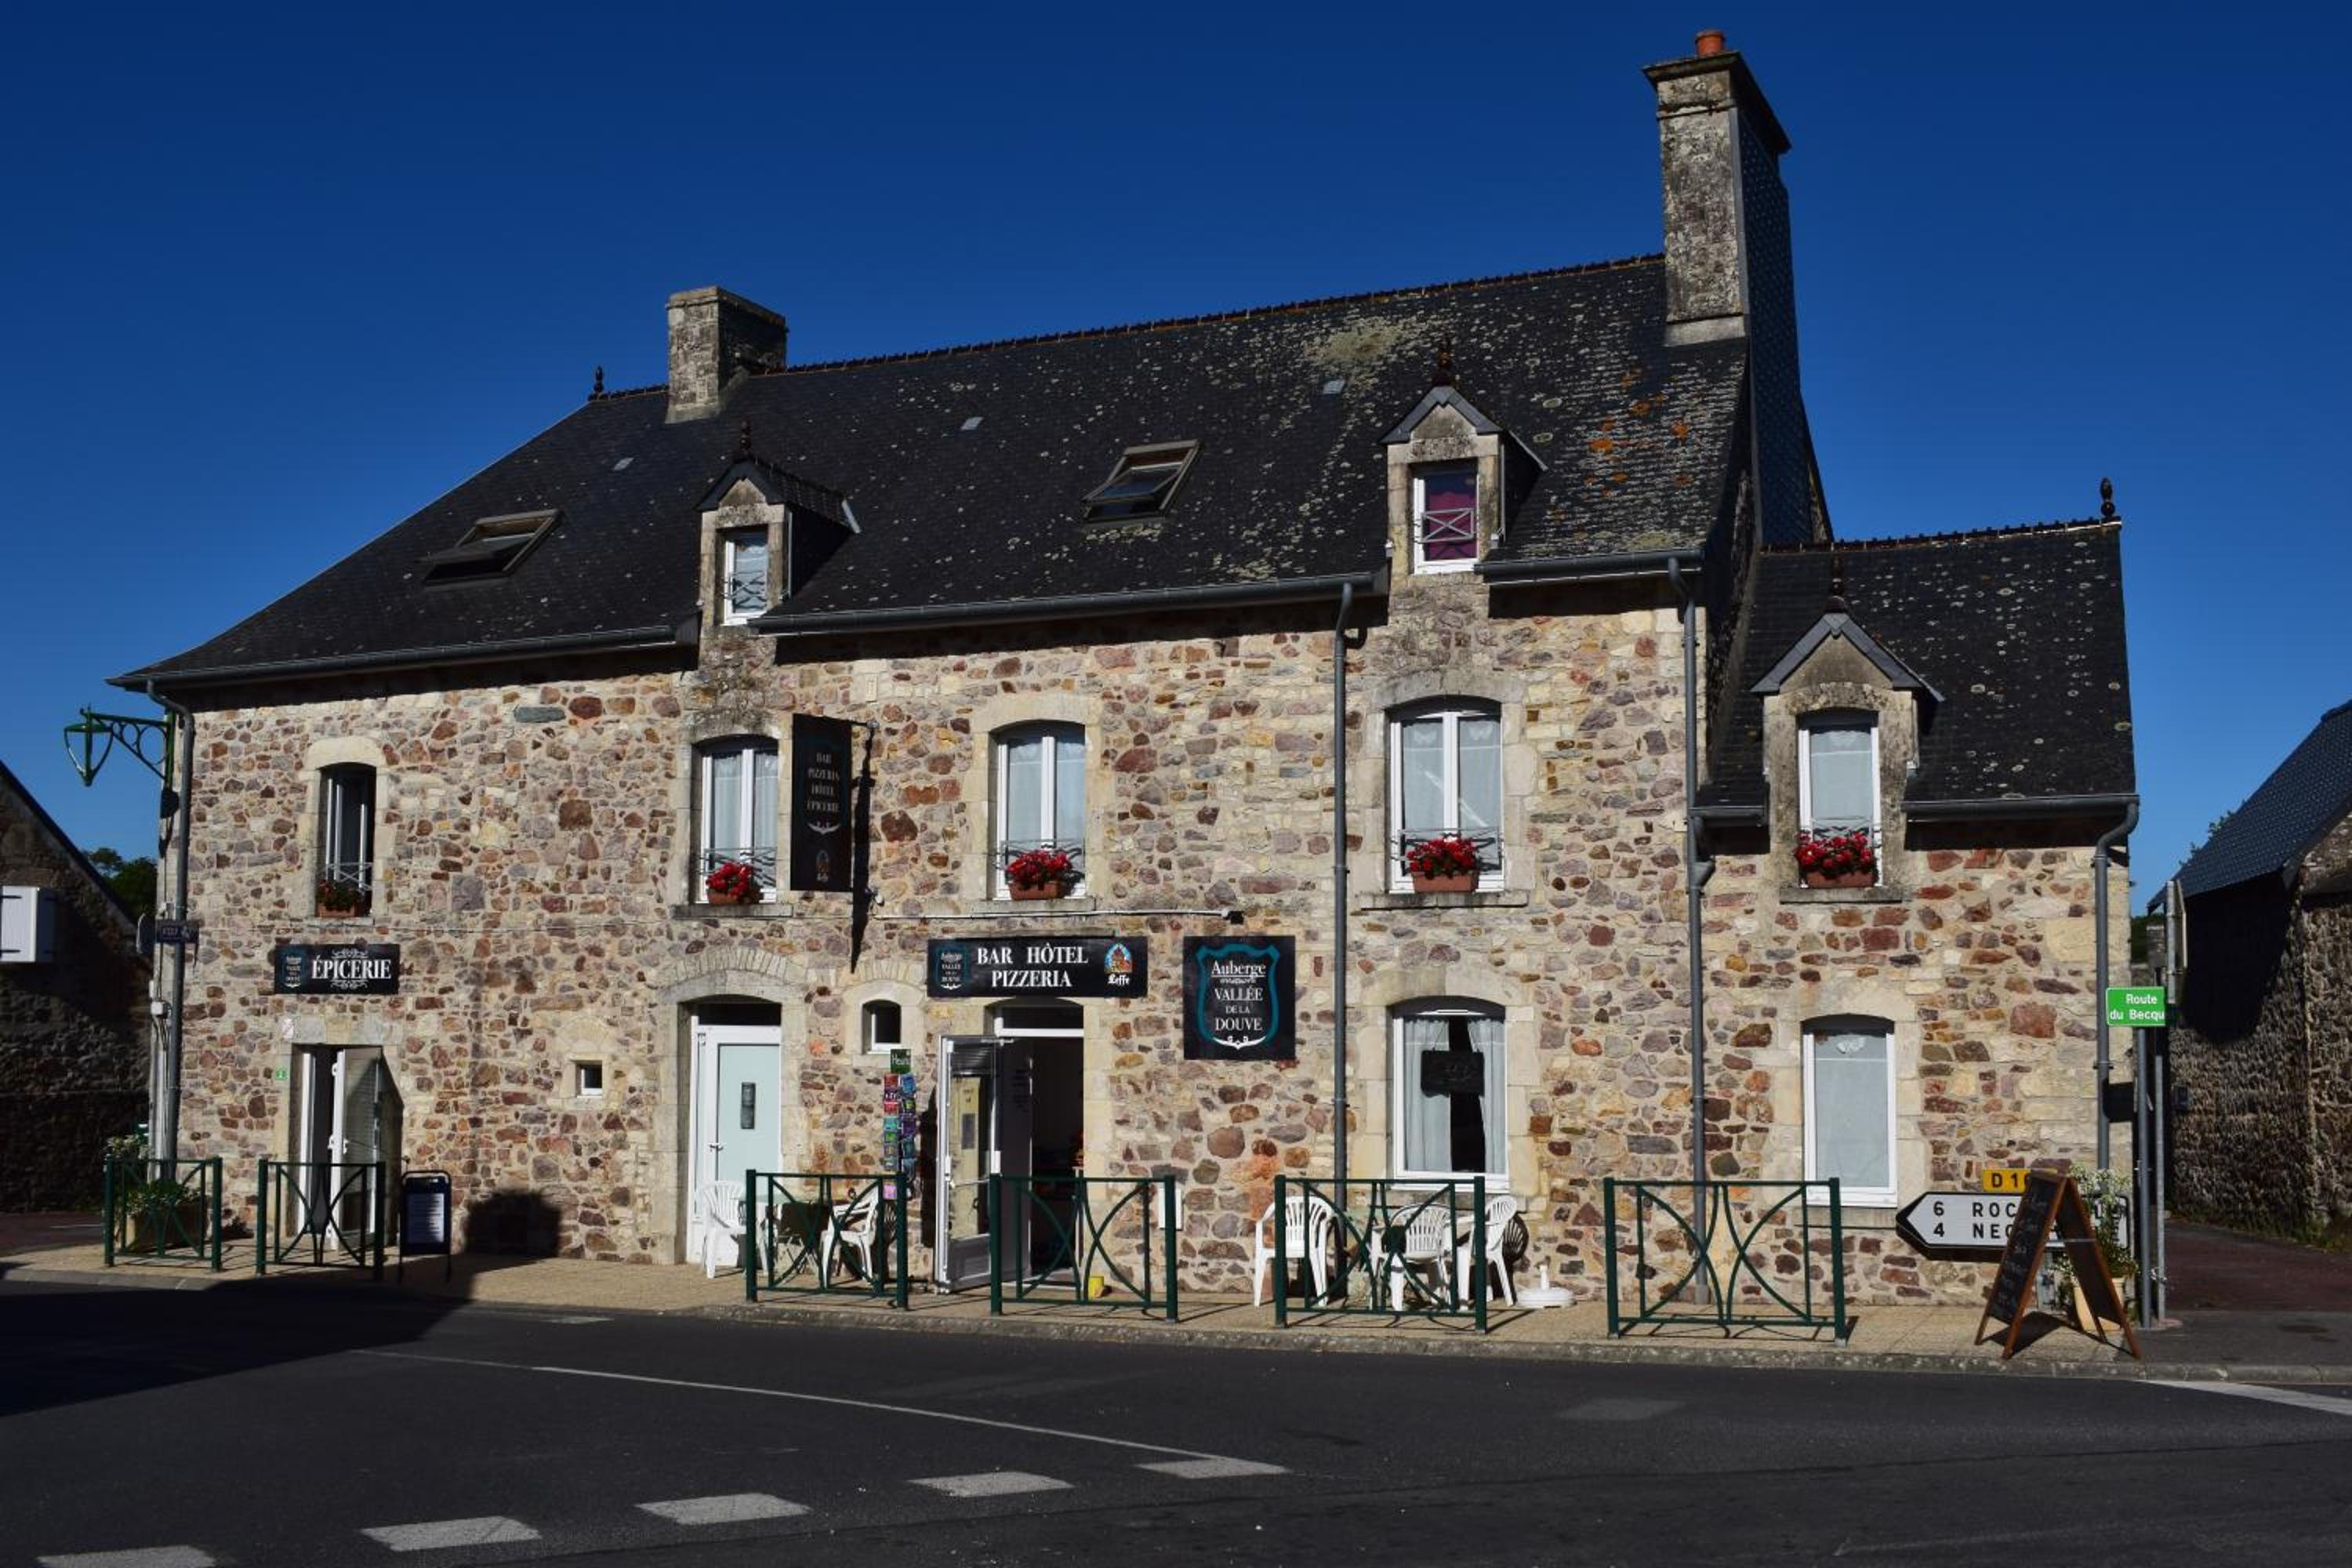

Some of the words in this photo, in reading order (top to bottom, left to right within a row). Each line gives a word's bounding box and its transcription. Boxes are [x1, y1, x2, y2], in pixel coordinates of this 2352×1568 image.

[978, 946, 1013, 964] BAR
[1027, 942, 1089, 964] HÔTEL
[312, 955, 392, 979] ÉPICERIE
[1211, 960, 1266, 978] Auberge
[991, 970, 1073, 988] PIZZERIA
[1214, 985, 1264, 1001] VALLÉE
[2125, 993, 2158, 1004] Route
[1225, 1005, 1237, 1014] DE
[1239, 1005, 1250, 1014] LA
[2109, 1009, 2124, 1020] du
[1214, 1018, 1263, 1031] DOUVE
[1933, 1201, 1945, 1217] 6
[1933, 1222, 1945, 1238] 4
